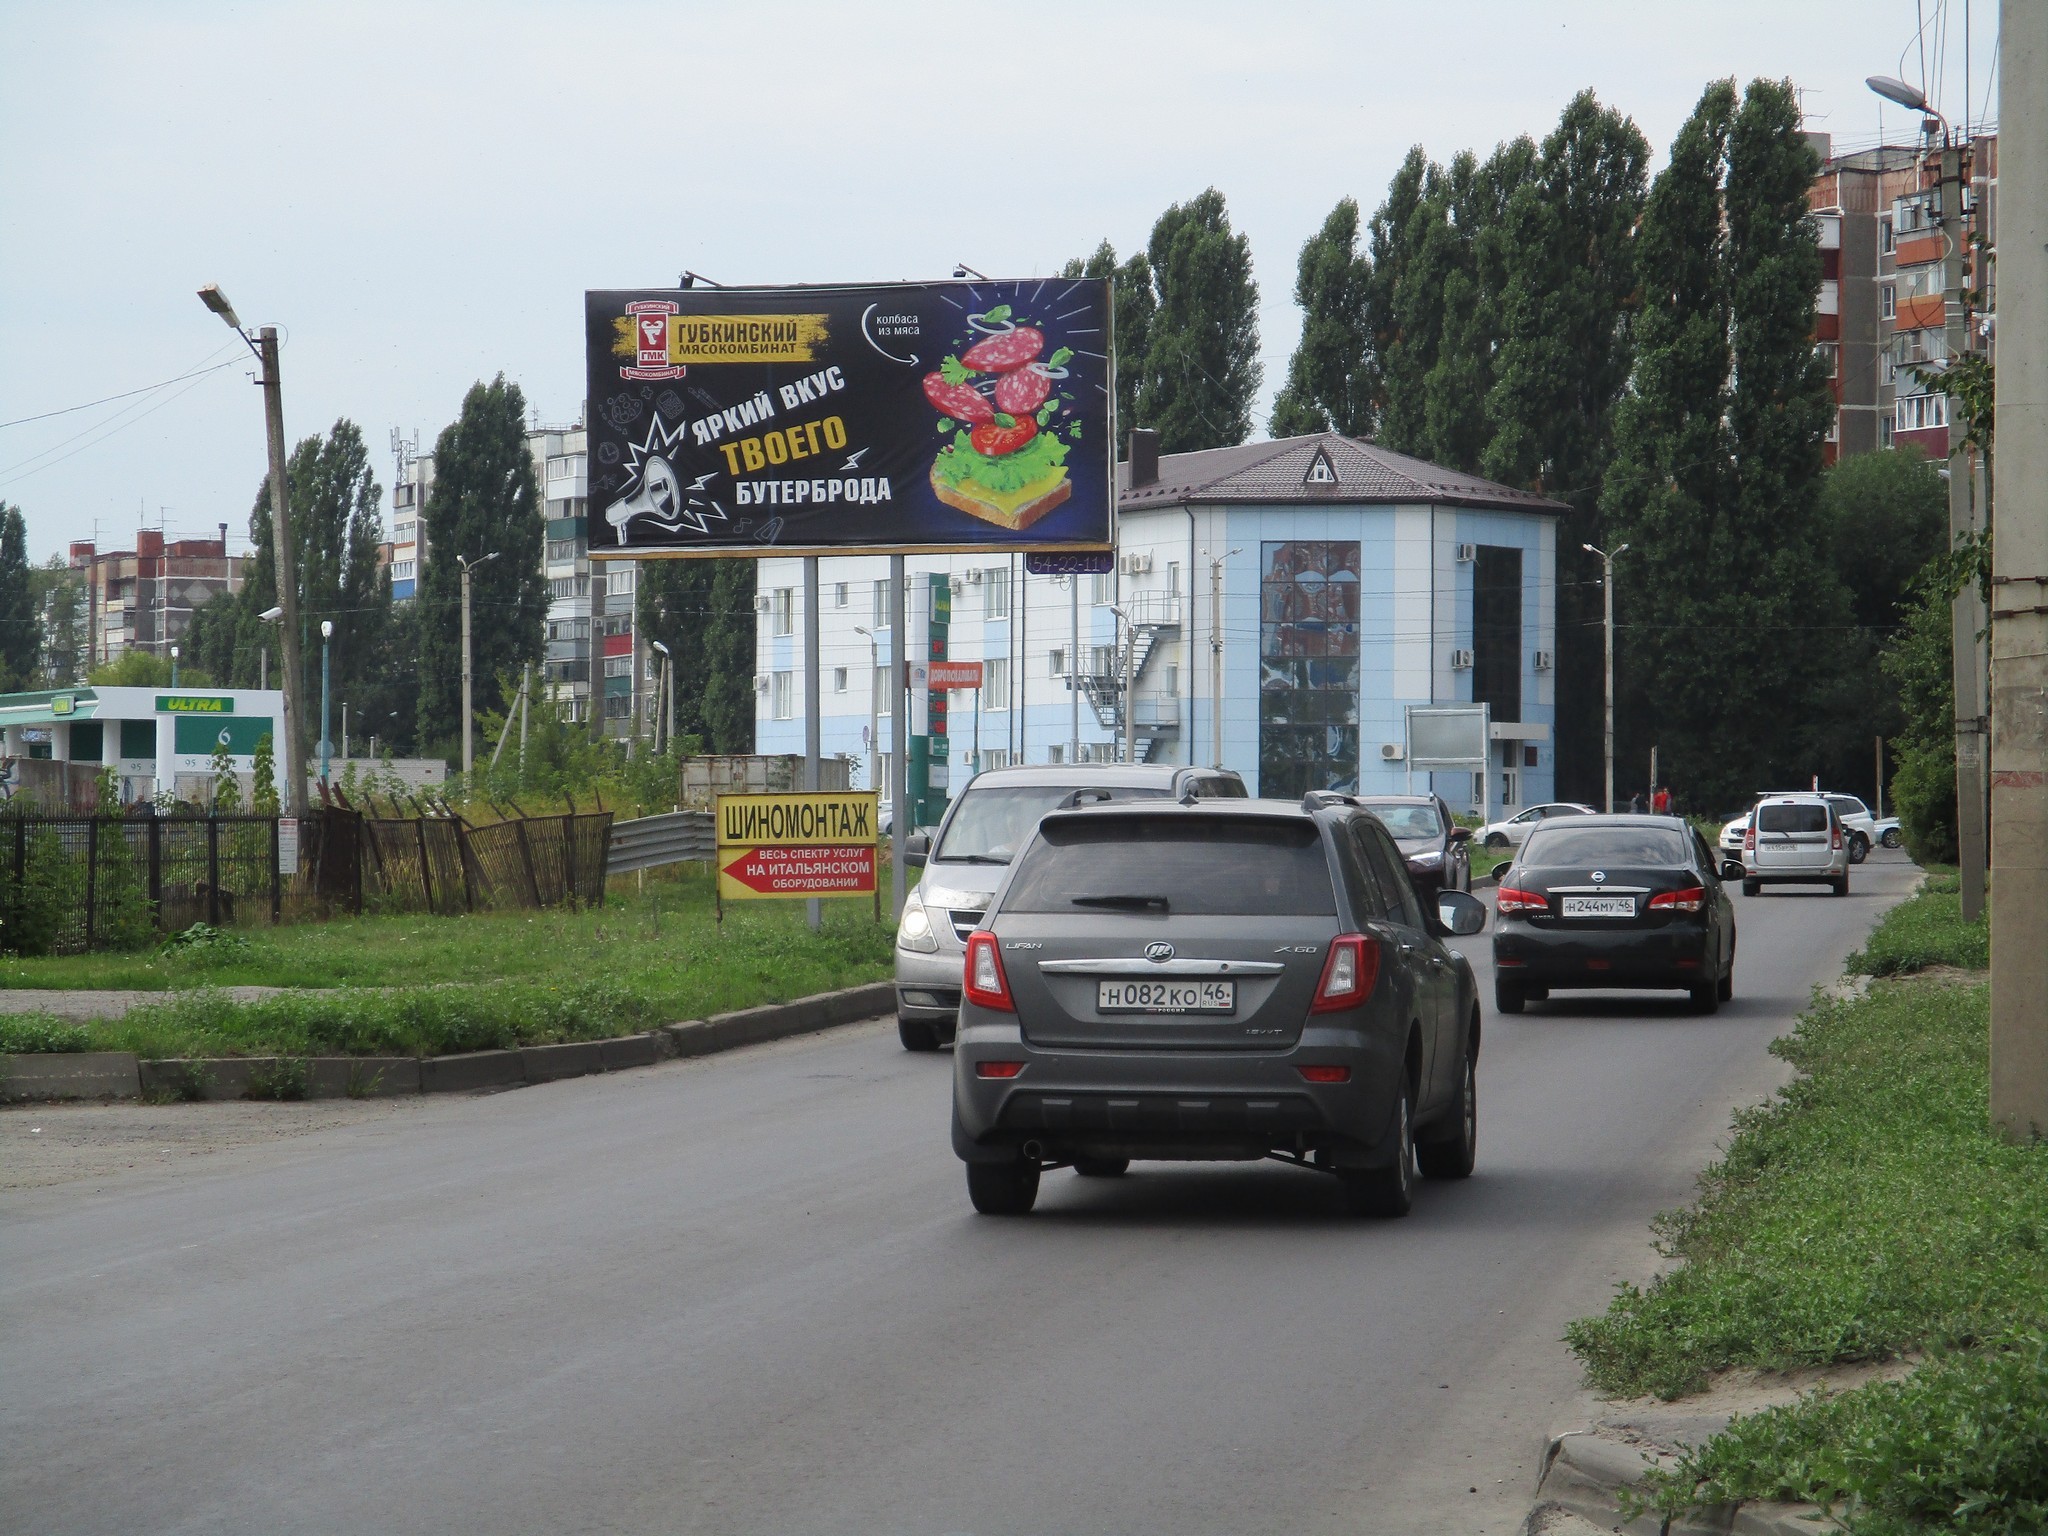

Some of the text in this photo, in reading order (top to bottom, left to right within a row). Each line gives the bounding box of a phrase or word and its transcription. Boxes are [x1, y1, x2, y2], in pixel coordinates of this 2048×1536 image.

[876, 313, 918, 325] колбаса
[677, 319, 797, 344] ГУБКИНСКИЙ
[878, 326, 920, 336] из мяса
[641, 351, 665, 360] ГМК
[679, 342, 796, 355] МЯСОКОМБИНАТ
[690, 365, 845, 446] ЯРКИЙ ВКУС
[719, 415, 848, 477] ТВОЕГО
[735, 476, 892, 506] БУТЕРБРОДА
[167, 697, 223, 712] ULTRA
[726, 803, 869, 839] ШИНОМОНТАЖ
[760, 848, 865, 859] ВЕСЬ СПЕКТР УСЛУГ
[747, 861, 870, 876] НА ИТАЛЬЯНСКОМ
[773, 878, 858, 889] ОБОРУДОВАНИИ
[1569, 899, 1630, 912] Н244МУ 46
[1108, 984, 1225, 1006] Н082КО 46
